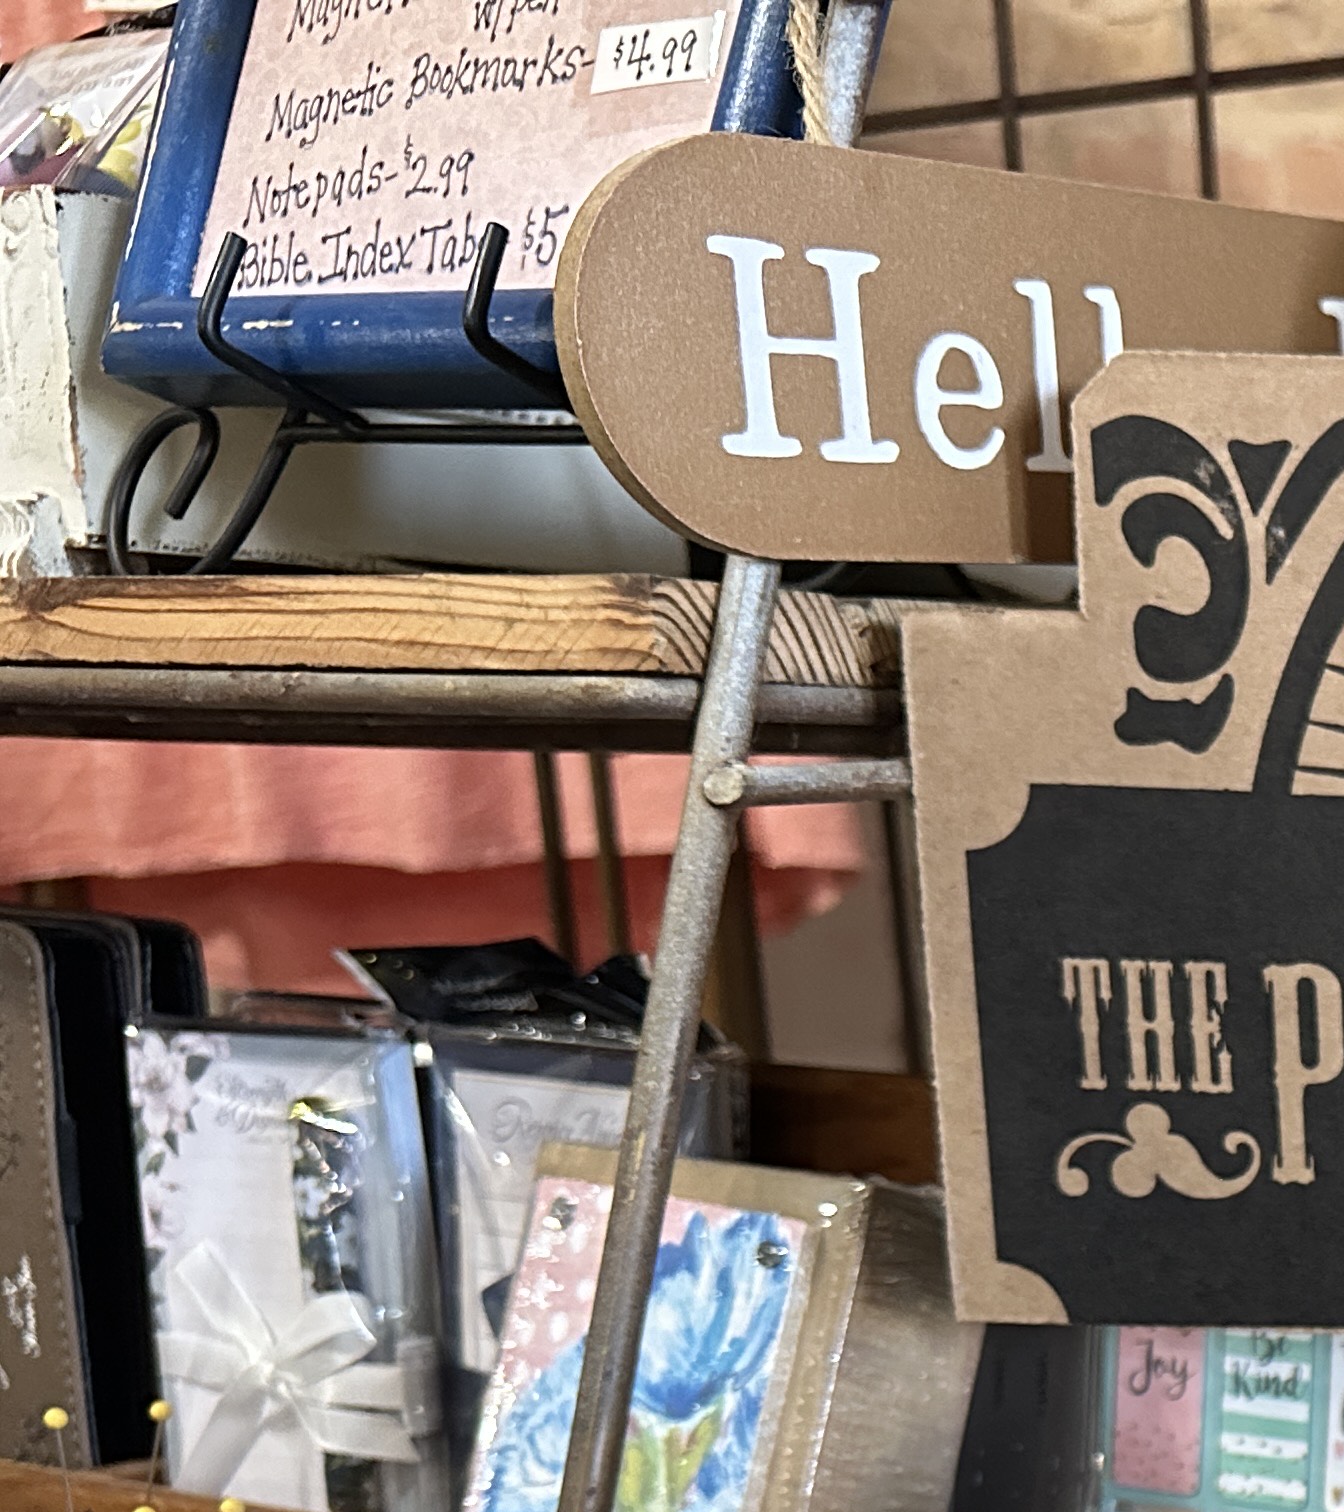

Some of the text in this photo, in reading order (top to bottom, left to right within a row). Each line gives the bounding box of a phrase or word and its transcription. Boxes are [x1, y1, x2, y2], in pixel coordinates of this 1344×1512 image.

[265, 61, 394, 148] Magnetic
[613, 29, 697, 80] $4.99
[404, 134, 474, 200] $2.99
[238, 231, 313, 290] Bible
[317, 218, 417, 285] Index
[420, 211, 509, 274] Tab
[1061, 957, 1233, 1094] THE
[1128, 1338, 1190, 1402] Joy
[1231, 1361, 1302, 1399] Kind
